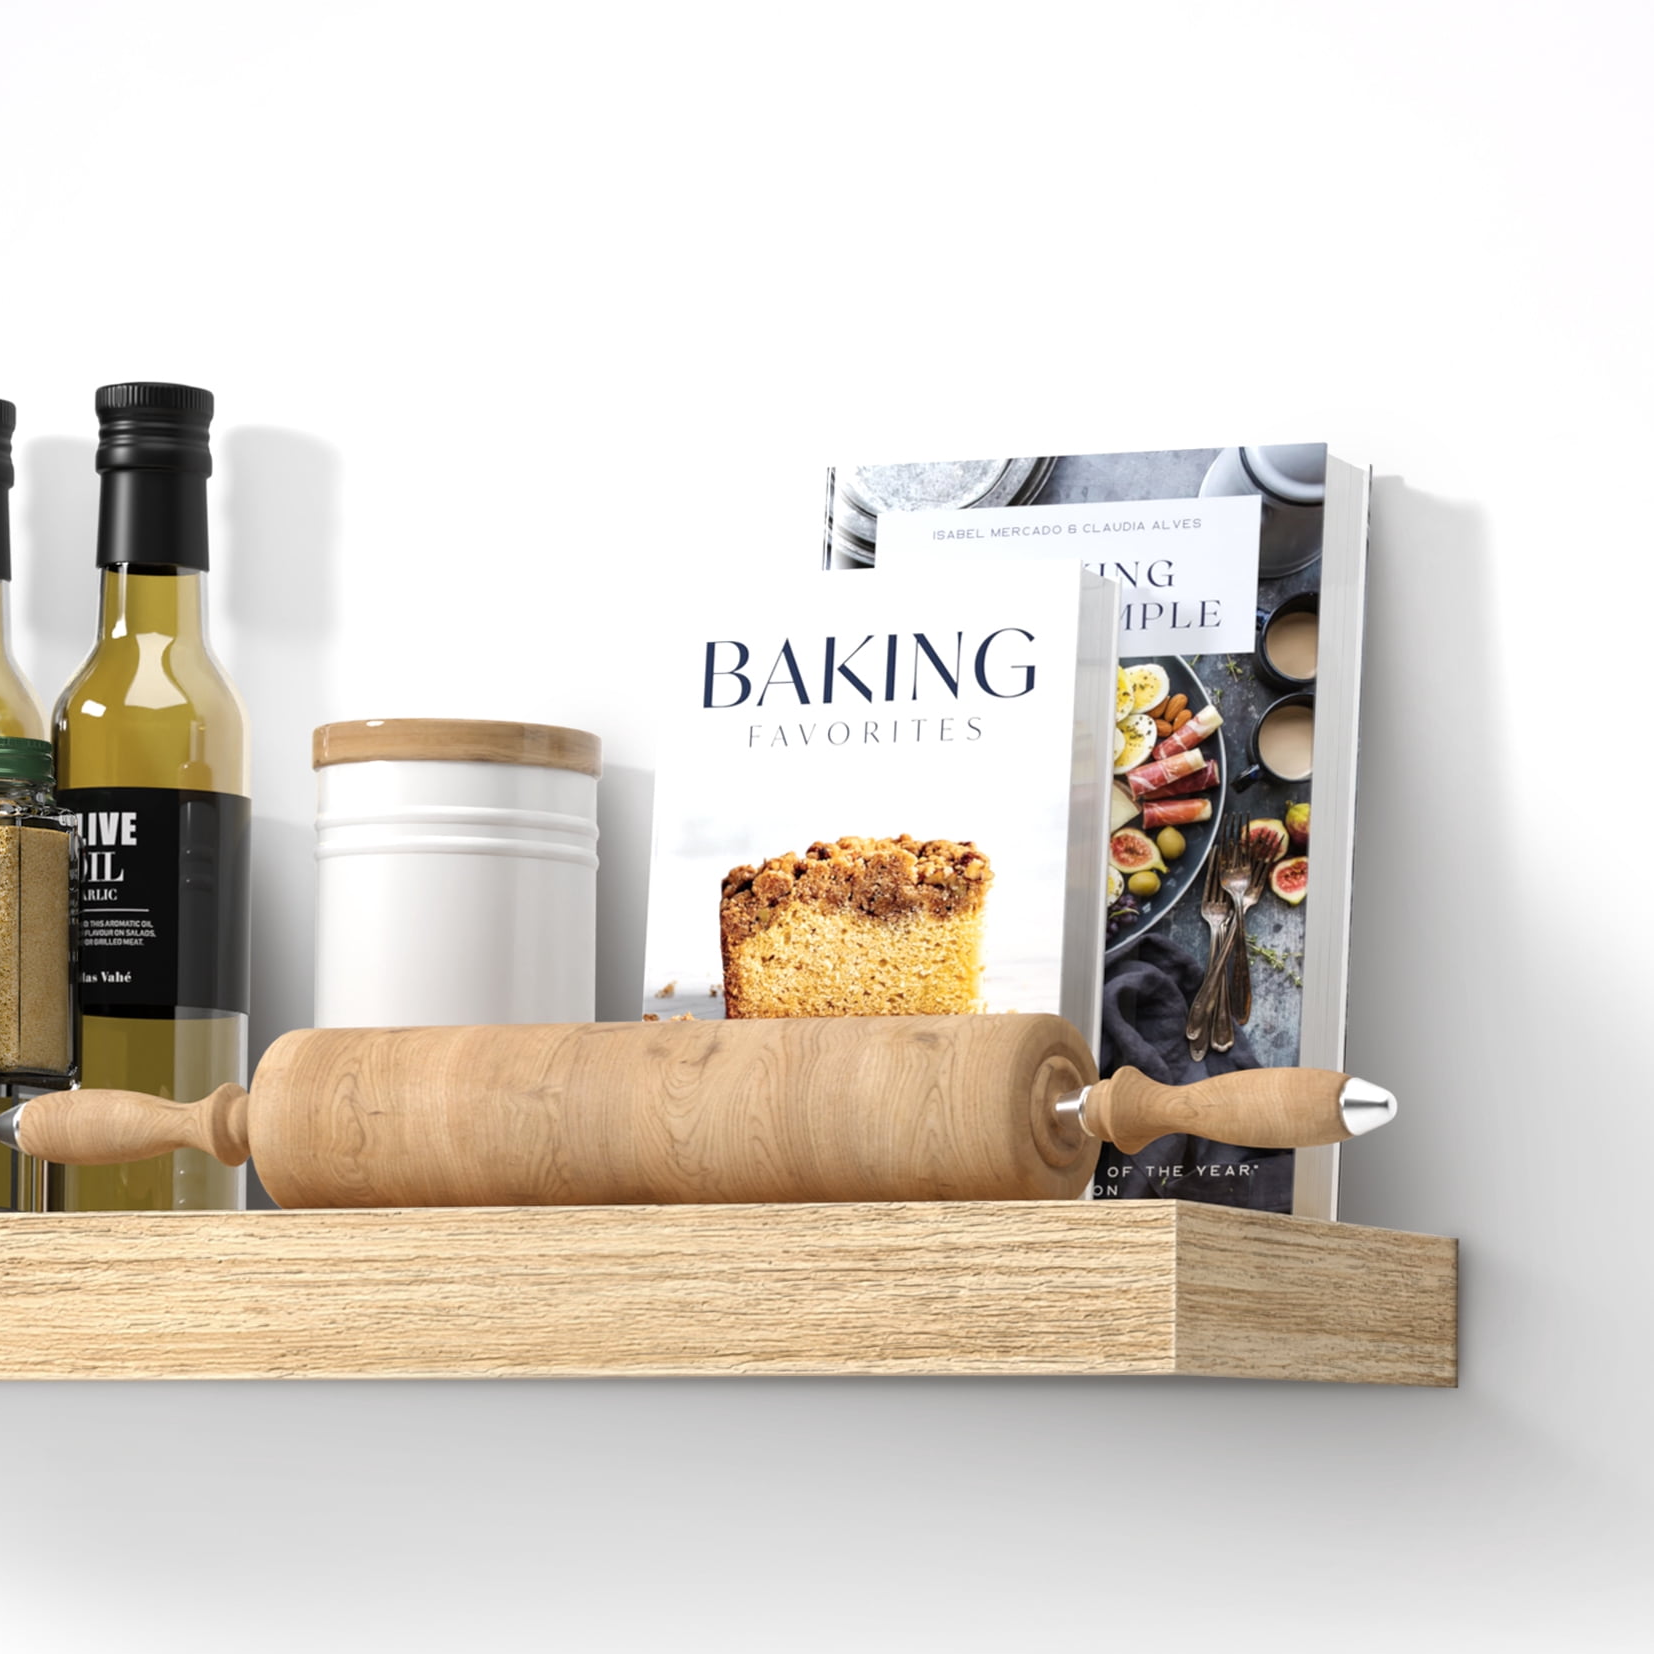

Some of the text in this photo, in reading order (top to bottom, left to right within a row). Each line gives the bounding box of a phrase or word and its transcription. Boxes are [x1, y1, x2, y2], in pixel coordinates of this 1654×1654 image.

[932, 528, 985, 541] ISABEL
[990, 524, 1063, 538] MERCADO
[1082, 520, 1146, 533] CLAUDIA
[1151, 517, 1202, 531] ALVES
[703, 627, 1036, 708] BAKING
[749, 716, 982, 748] FAVORITES
[83, 888, 118, 901] RLIC
[101, 971, 132, 983] Vahé
[1107, 1166, 1133, 1177] OF
[1145, 1165, 1184, 1177] THE
